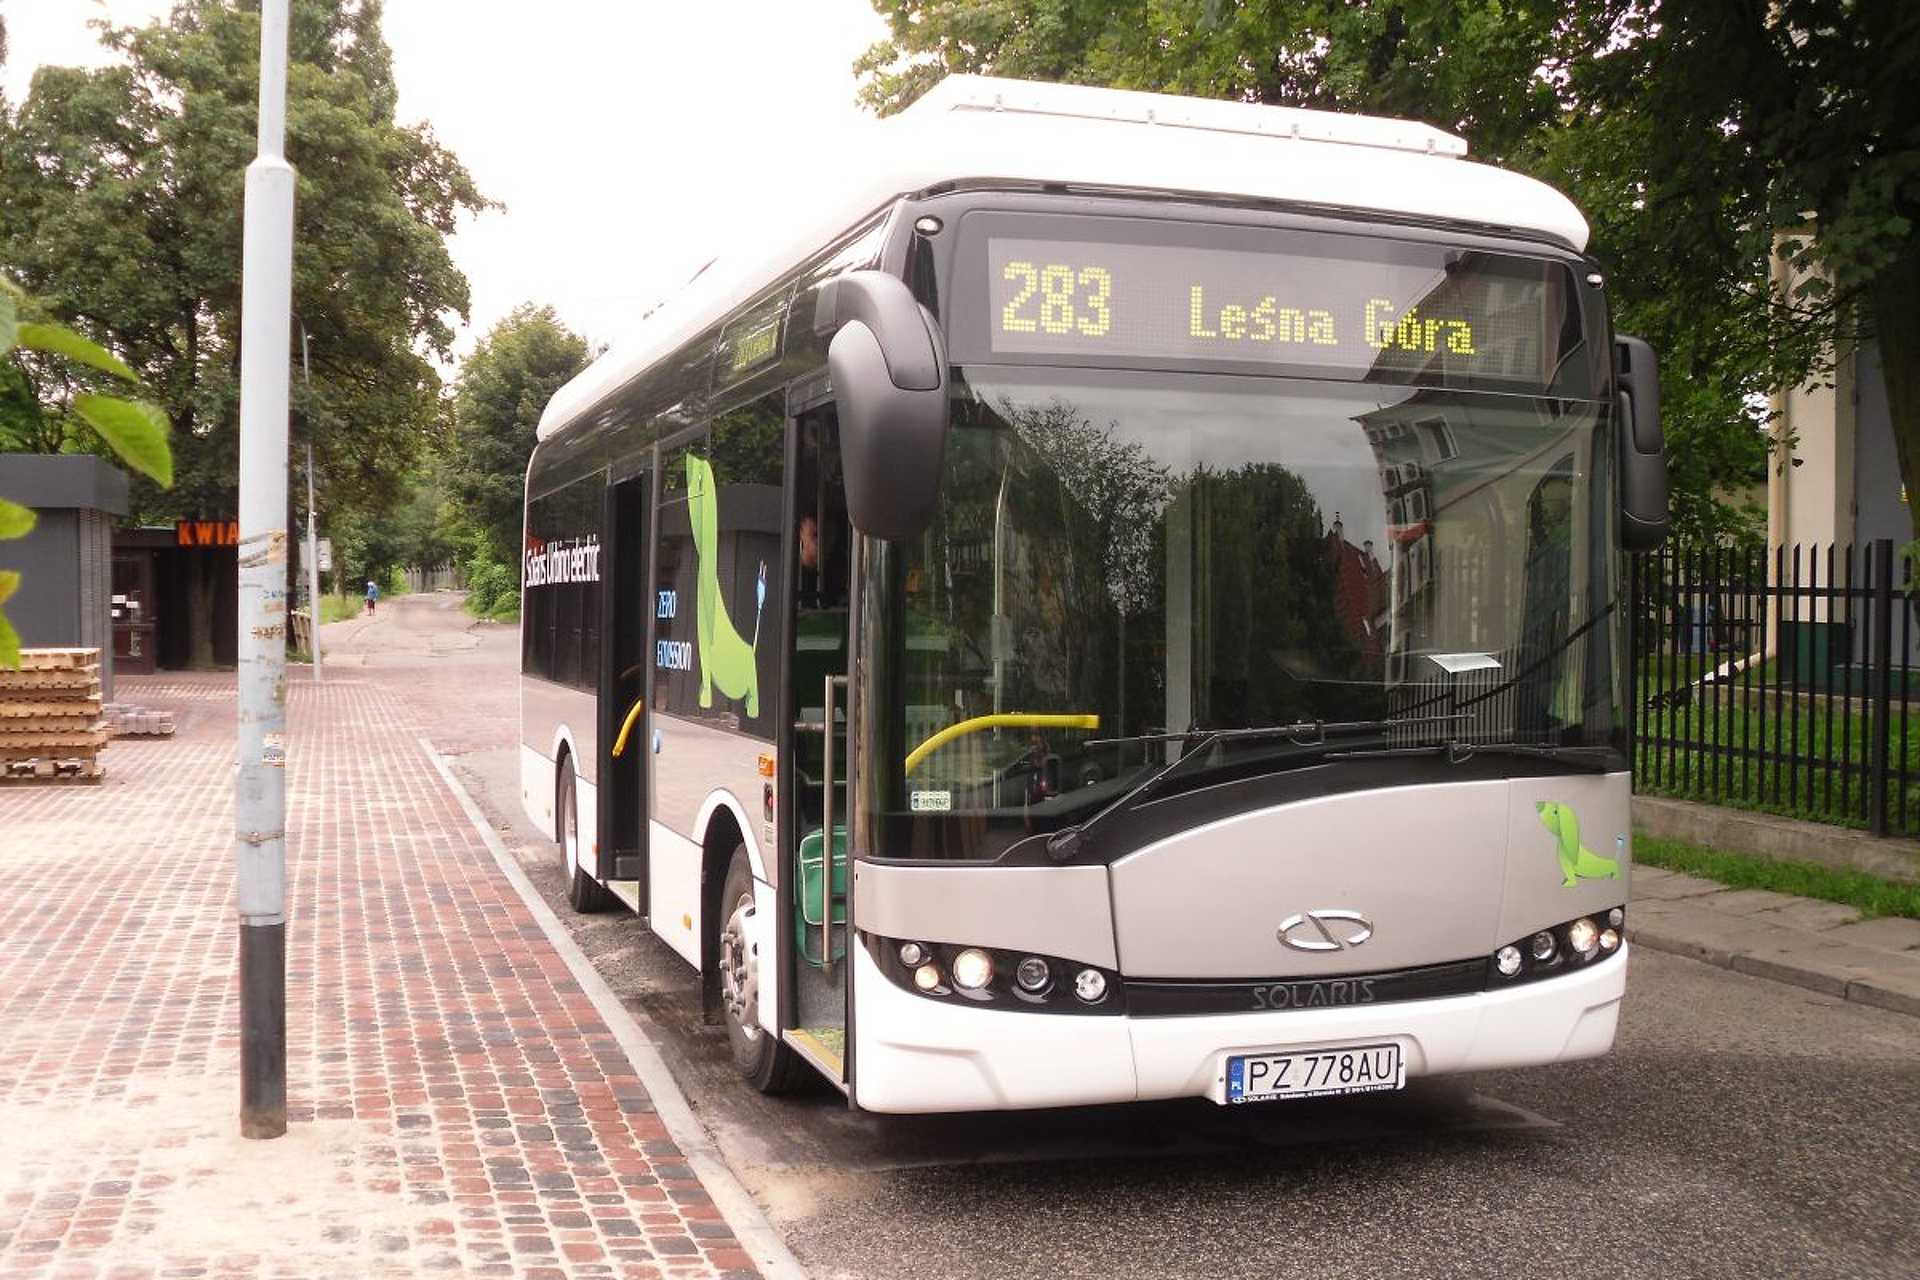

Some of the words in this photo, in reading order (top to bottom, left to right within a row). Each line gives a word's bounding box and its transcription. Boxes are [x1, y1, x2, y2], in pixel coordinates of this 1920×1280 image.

[1003, 262, 1111, 336] 283
[1190, 285, 1338, 345] Leśna
[1364, 298, 1475, 355] Góra
[546, 540, 570, 584] Urbino
[570, 533, 600, 582] electric
[657, 590, 677, 619] ZERO
[1252, 980, 1375, 1010] SOLARIS
[1249, 1059, 1292, 1092] PZ
[1303, 1050, 1393, 1087] 778AU
